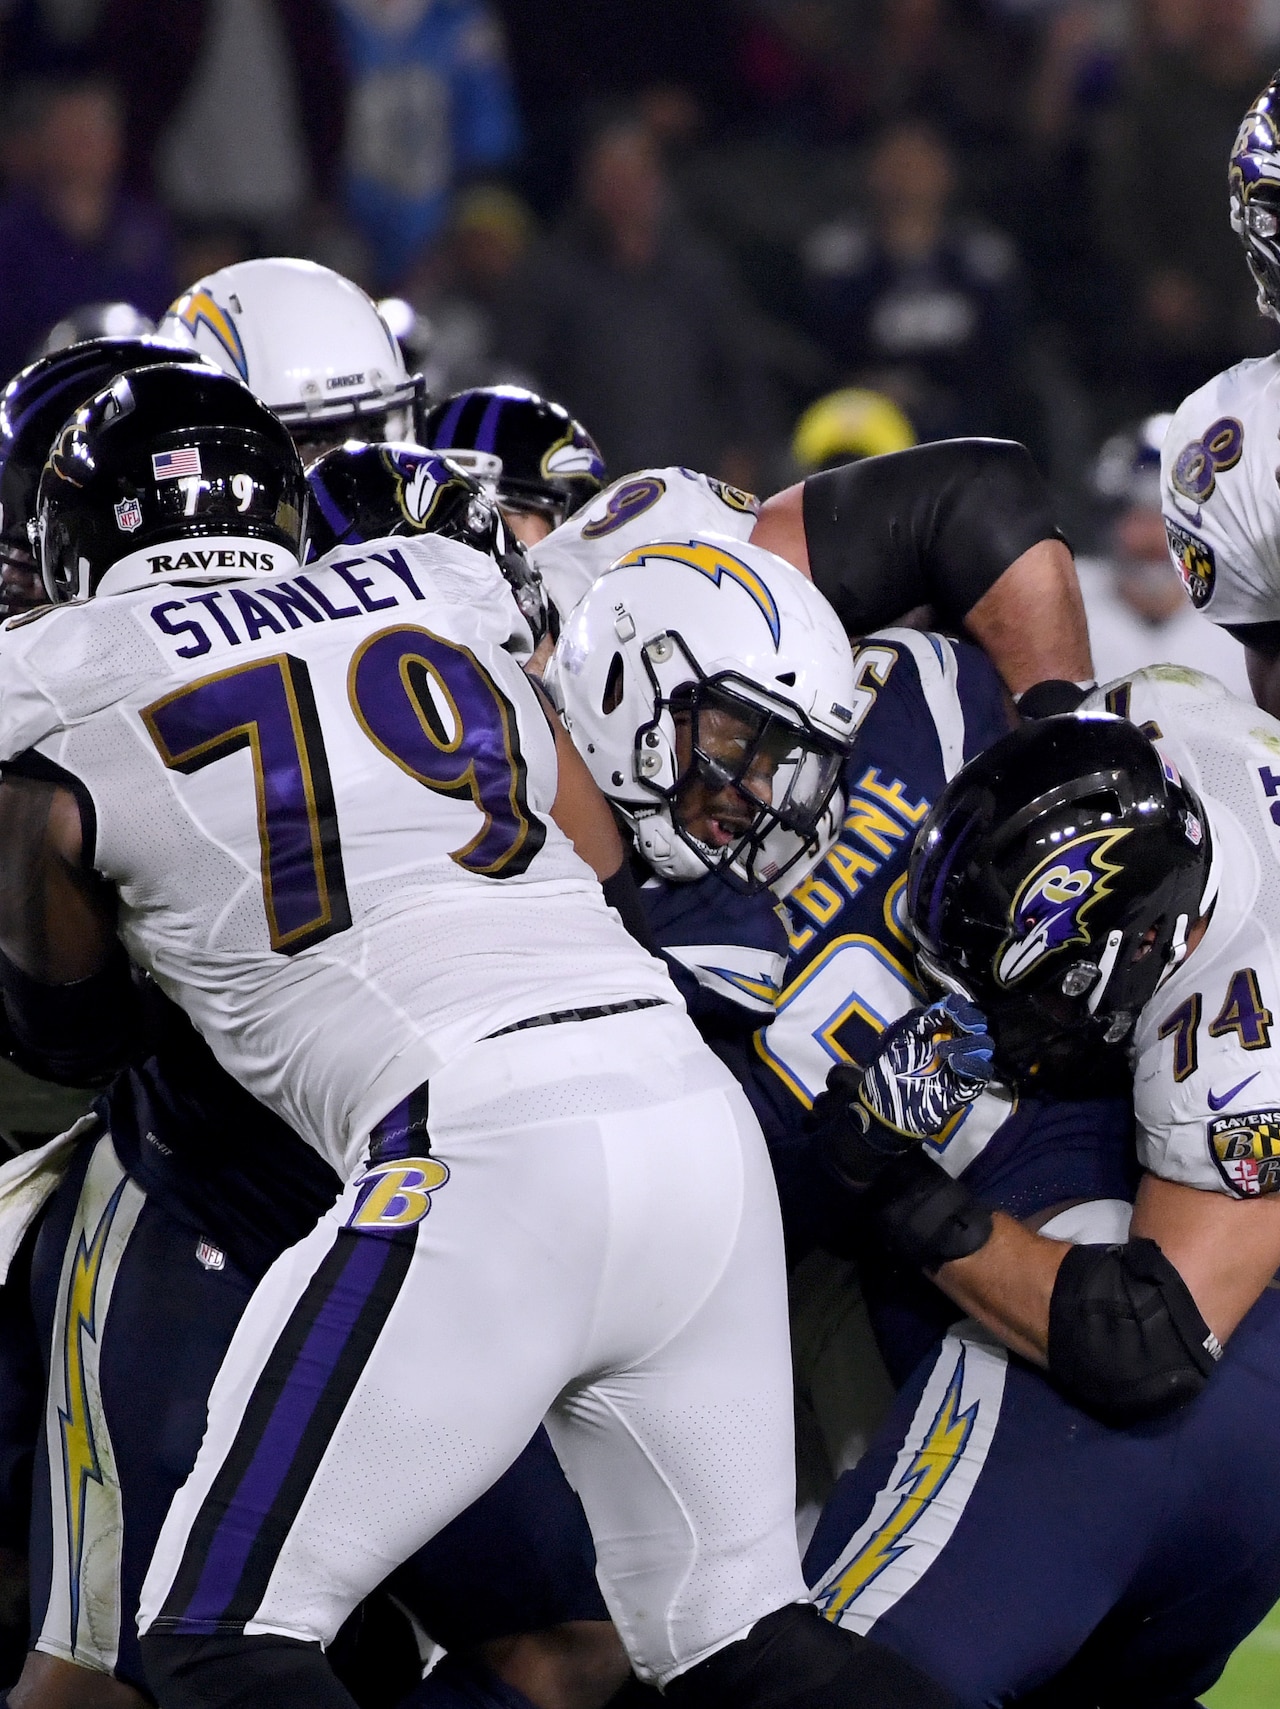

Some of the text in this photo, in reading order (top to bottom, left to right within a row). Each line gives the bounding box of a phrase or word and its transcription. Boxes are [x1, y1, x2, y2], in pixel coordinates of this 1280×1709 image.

[1172, 416, 1245, 505] 8
[177, 473, 254, 517] 79
[120, 510, 141, 527] NFL
[146, 550, 275, 575] RAVENS
[150, 548, 427, 660] STANLEY
[614, 602, 626, 617] 31
[139, 623, 547, 957] 79
[1158, 967, 1274, 1083] 74
[201, 1242, 222, 1265] NFL
